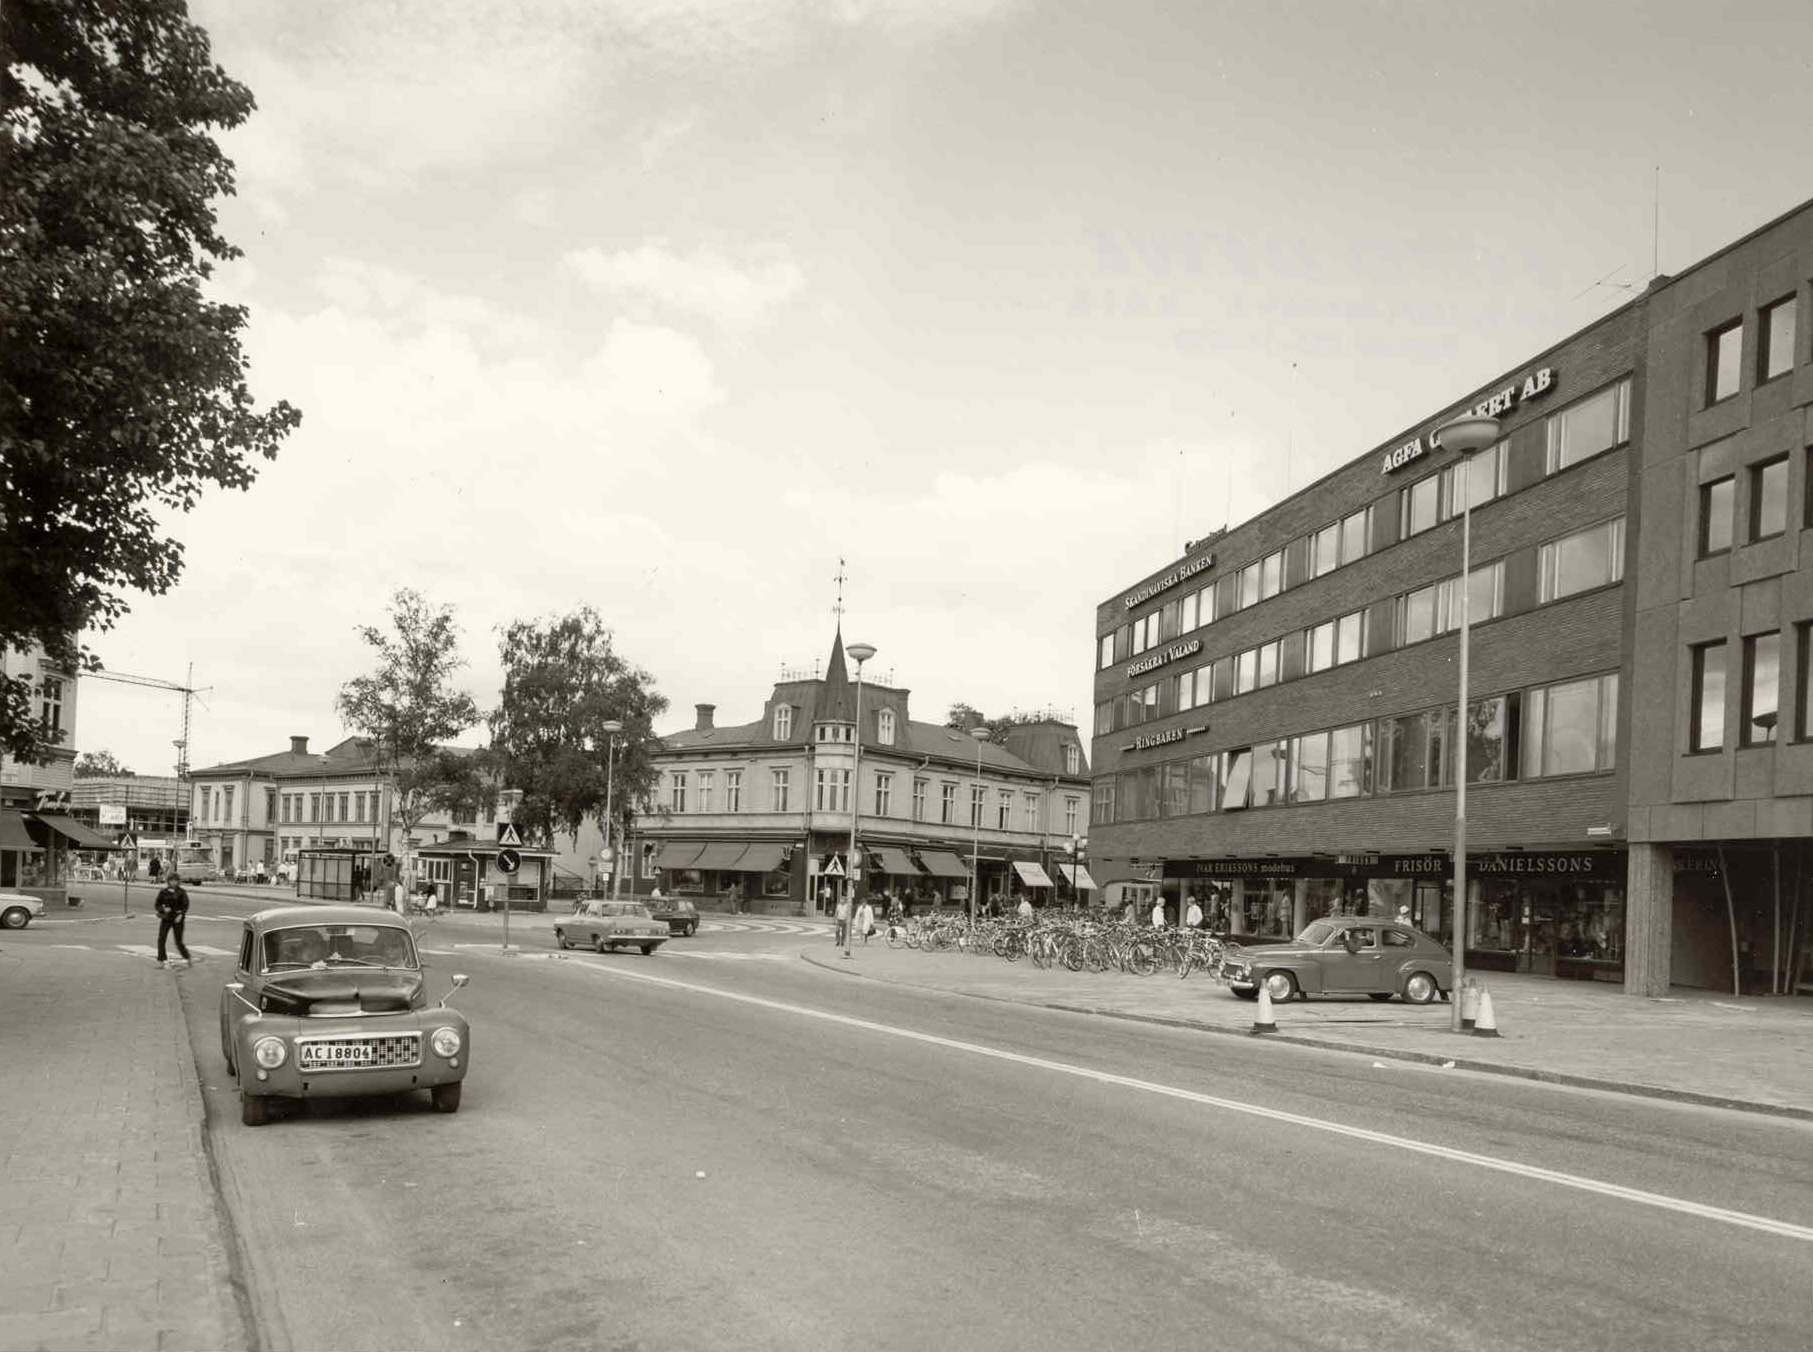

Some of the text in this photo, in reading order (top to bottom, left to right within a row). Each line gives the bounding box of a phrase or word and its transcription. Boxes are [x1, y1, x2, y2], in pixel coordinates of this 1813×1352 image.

[1381, 368, 1551, 474] AGFA GERT AB
[1179, 554, 1212, 580] BANKEN
[1136, 728, 1184, 750] RINGBAREN
[1395, 857, 1442, 873] FRISÖR
[1479, 857, 1593, 873] DANIELSSONS
